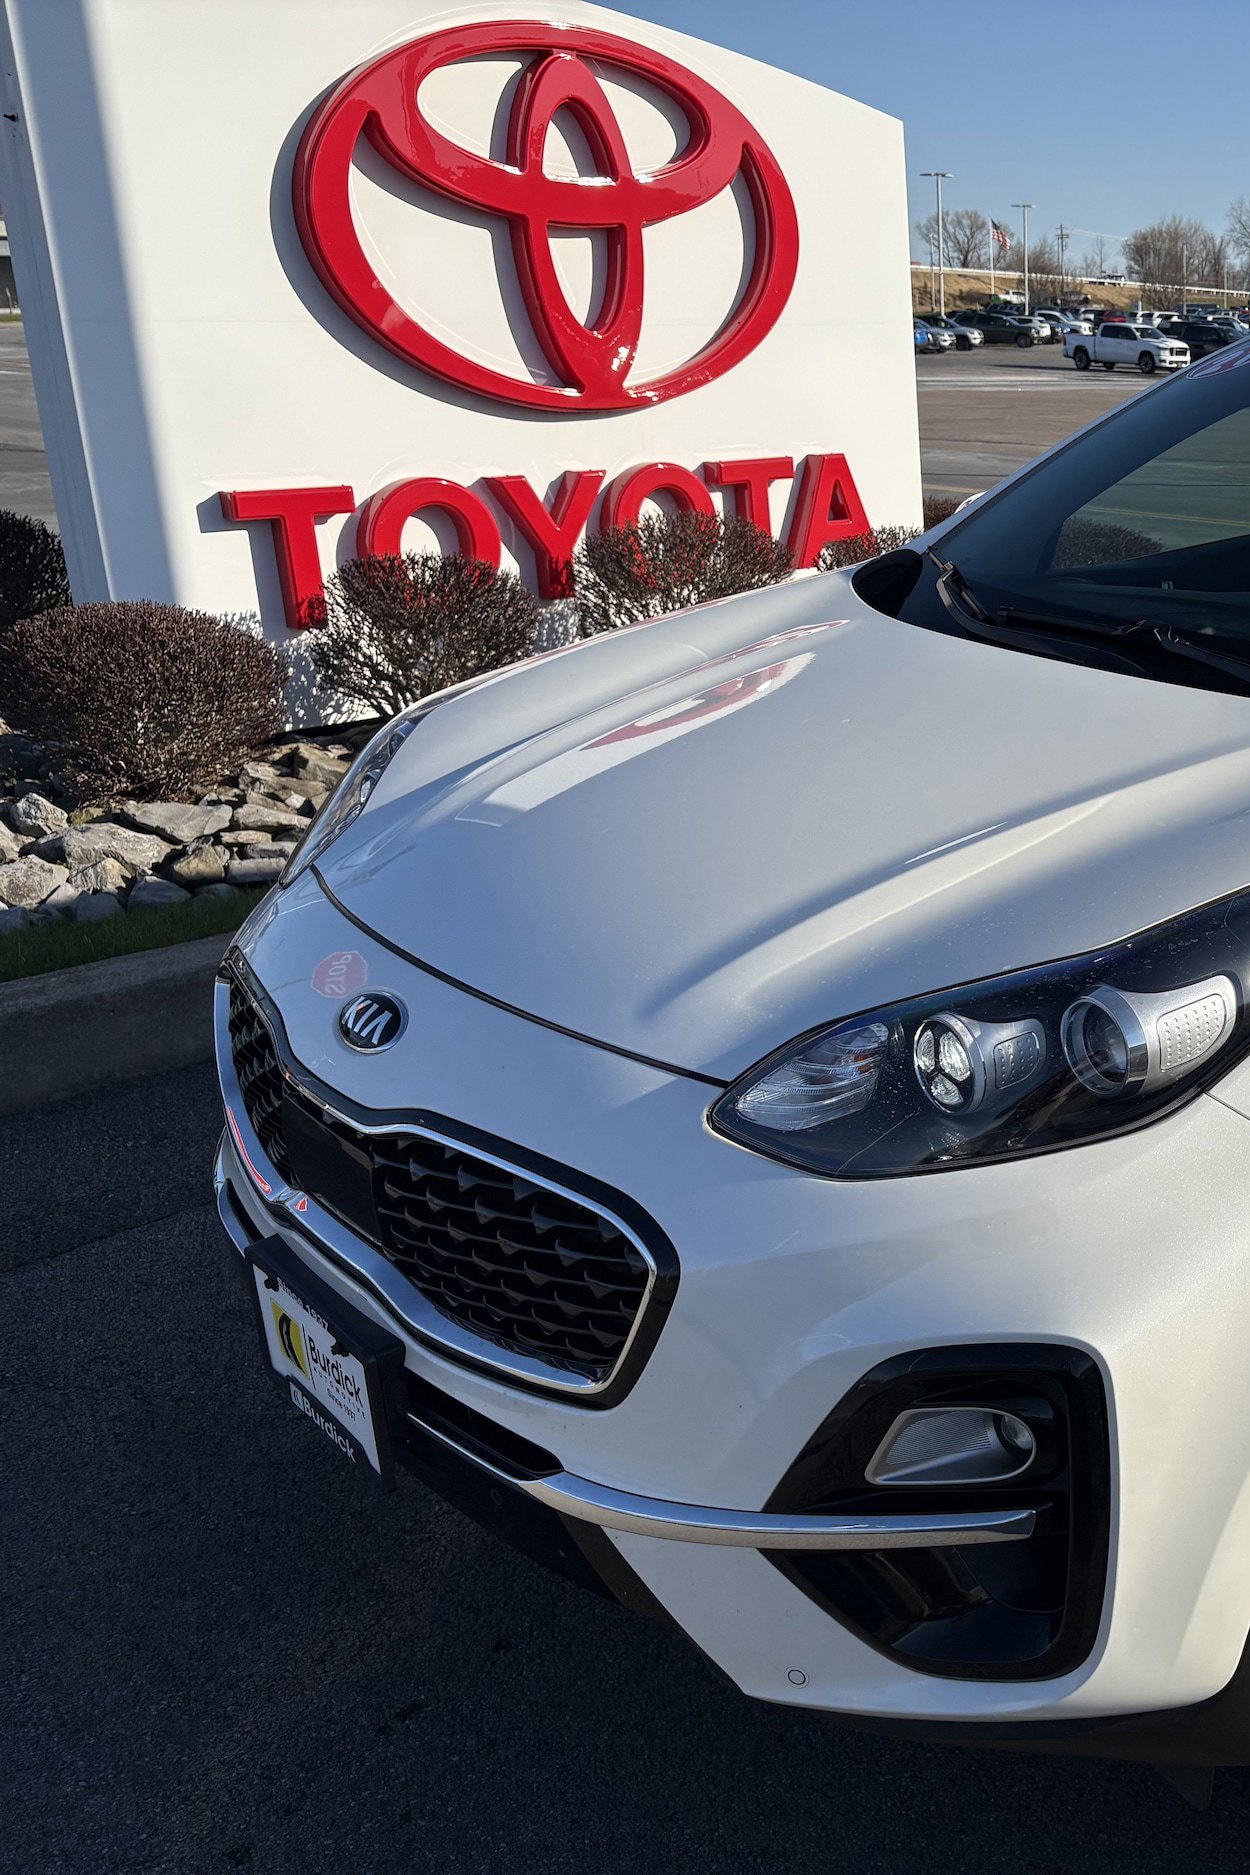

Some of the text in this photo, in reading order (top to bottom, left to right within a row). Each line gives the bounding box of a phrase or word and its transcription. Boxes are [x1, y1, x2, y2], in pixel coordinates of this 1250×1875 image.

[341, 995, 393, 1045] KIA
[307, 1334, 364, 1409] Burdick
[303, 1396, 357, 1464] Burdick
